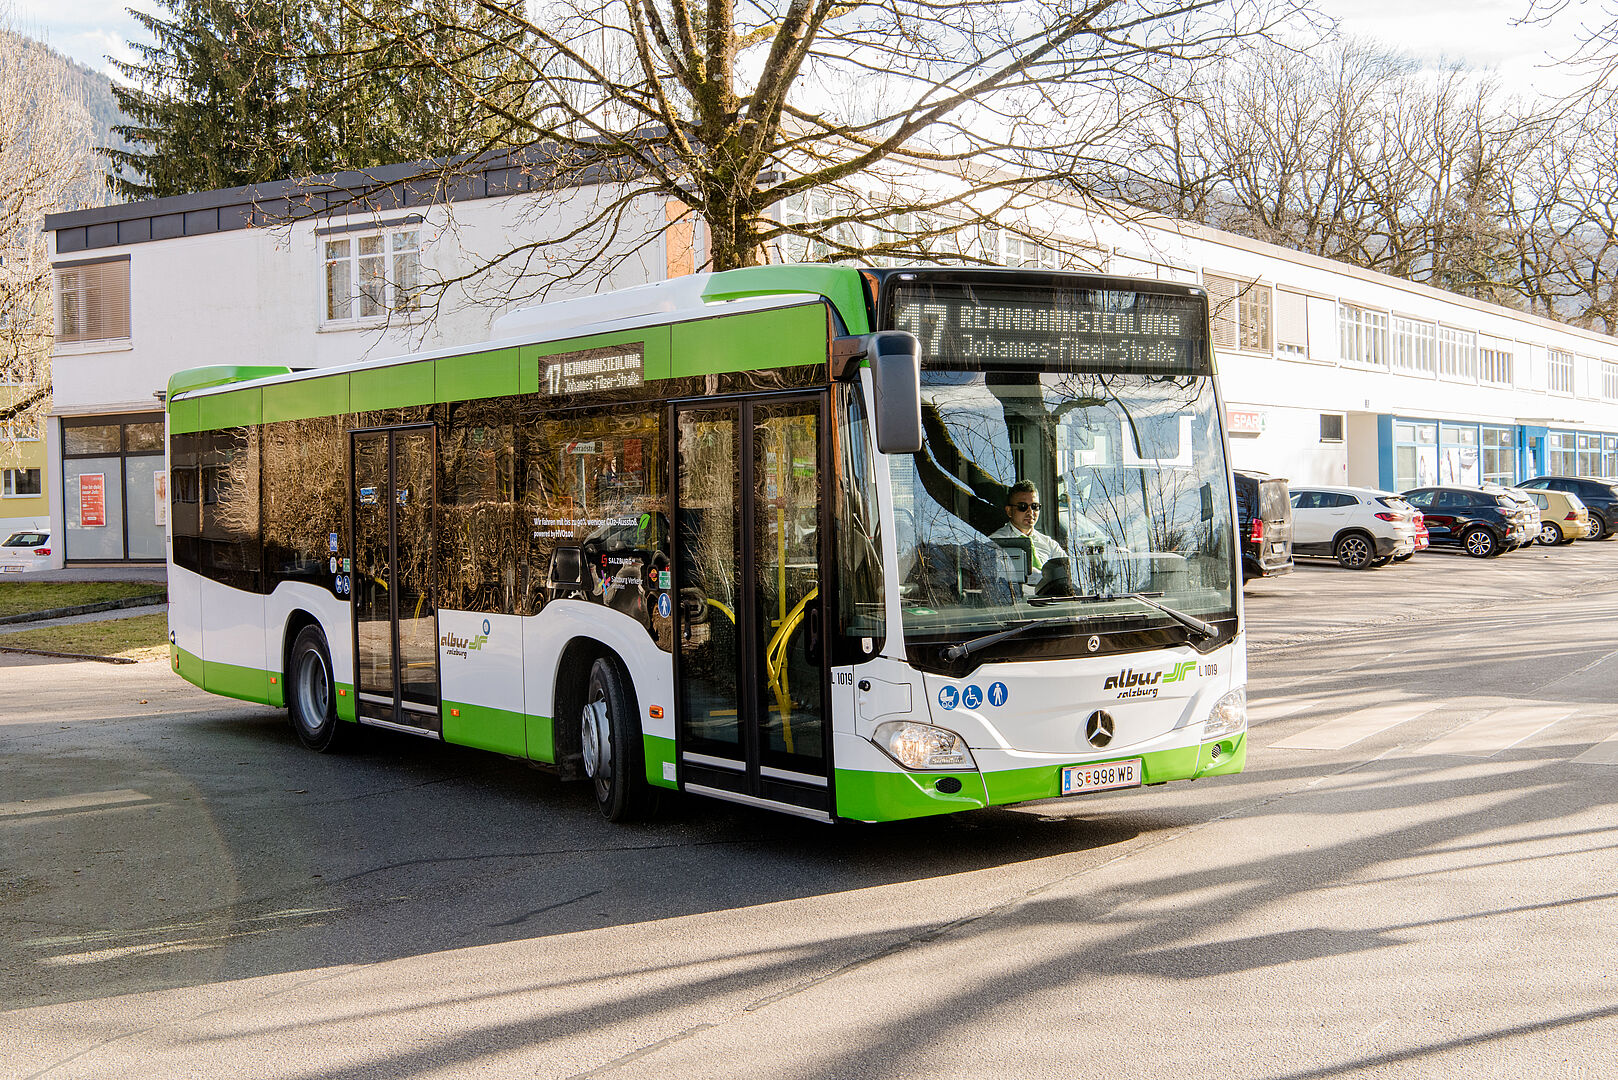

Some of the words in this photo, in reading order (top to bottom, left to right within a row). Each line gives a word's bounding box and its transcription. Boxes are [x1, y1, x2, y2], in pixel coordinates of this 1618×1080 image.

[898, 303, 947, 356] 17
[960, 305, 1180, 336] RENNBAHNSIEDLUNG
[961, 334, 1177, 362] Johannes-Filzer-Straße
[546, 364, 561, 395] 17
[563, 353, 641, 377] RENNBAHNSIEDLUNG
[564, 371, 640, 393] Johannes-Filzer-Straße
[1233, 413, 1259, 428] SPAR
[541, 517, 556, 526] fahren
[587, 518, 606, 528] weniger
[533, 531, 550, 539] powered
[608, 557, 632, 565] SALZBURG
[440, 632, 469, 648] albus
[446, 649, 467, 659] salzburg
[1198, 665, 1203, 677] L
[1204, 663, 1218, 677] 1019
[836, 671, 853, 686] 1019
[1103, 667, 1162, 690] albus
[1116, 687, 1159, 699] salzburg
[1077, 771, 1084, 788] S
